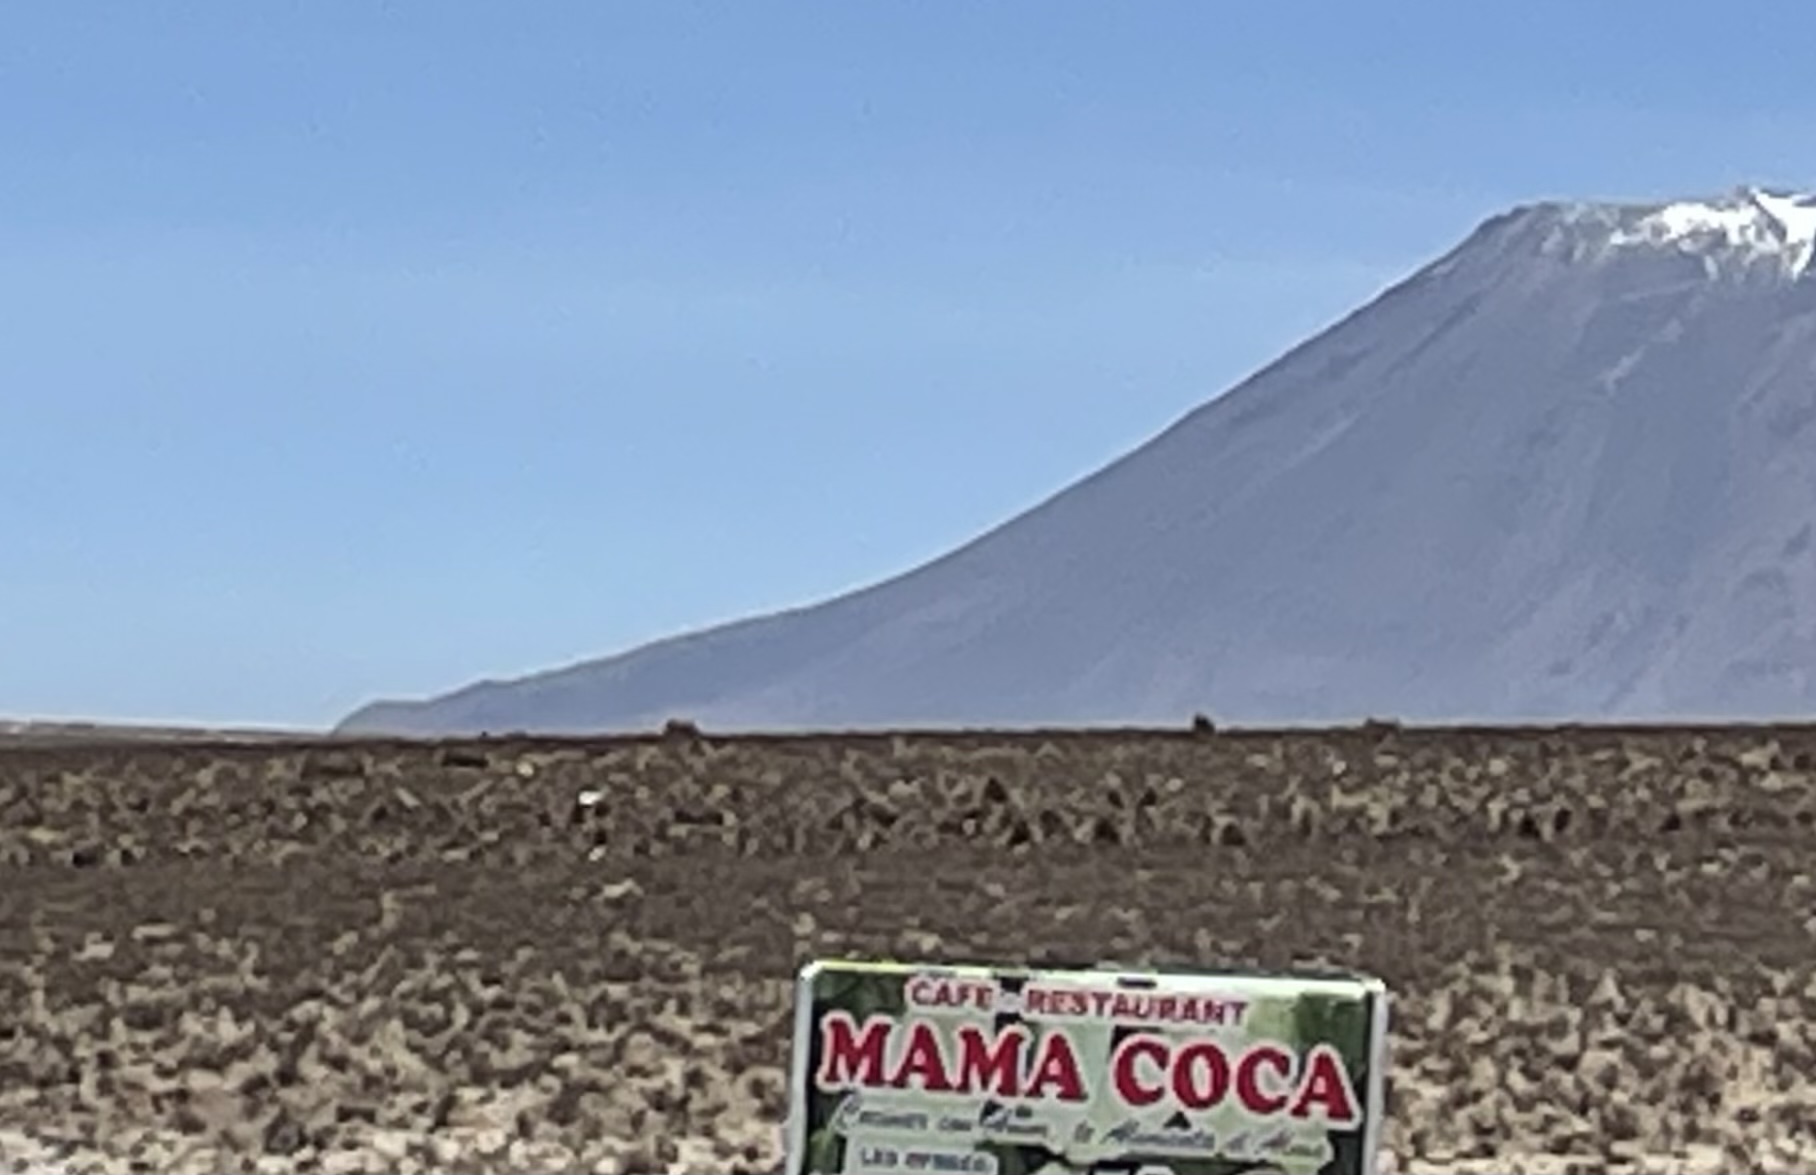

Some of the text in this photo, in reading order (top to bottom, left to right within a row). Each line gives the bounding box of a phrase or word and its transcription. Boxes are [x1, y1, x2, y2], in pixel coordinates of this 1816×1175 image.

[910, 980, 1248, 1024] CAFE RESTAURANT
[822, 1017, 1089, 1103] MAMA
[1112, 1038, 1357, 1122] COCA
